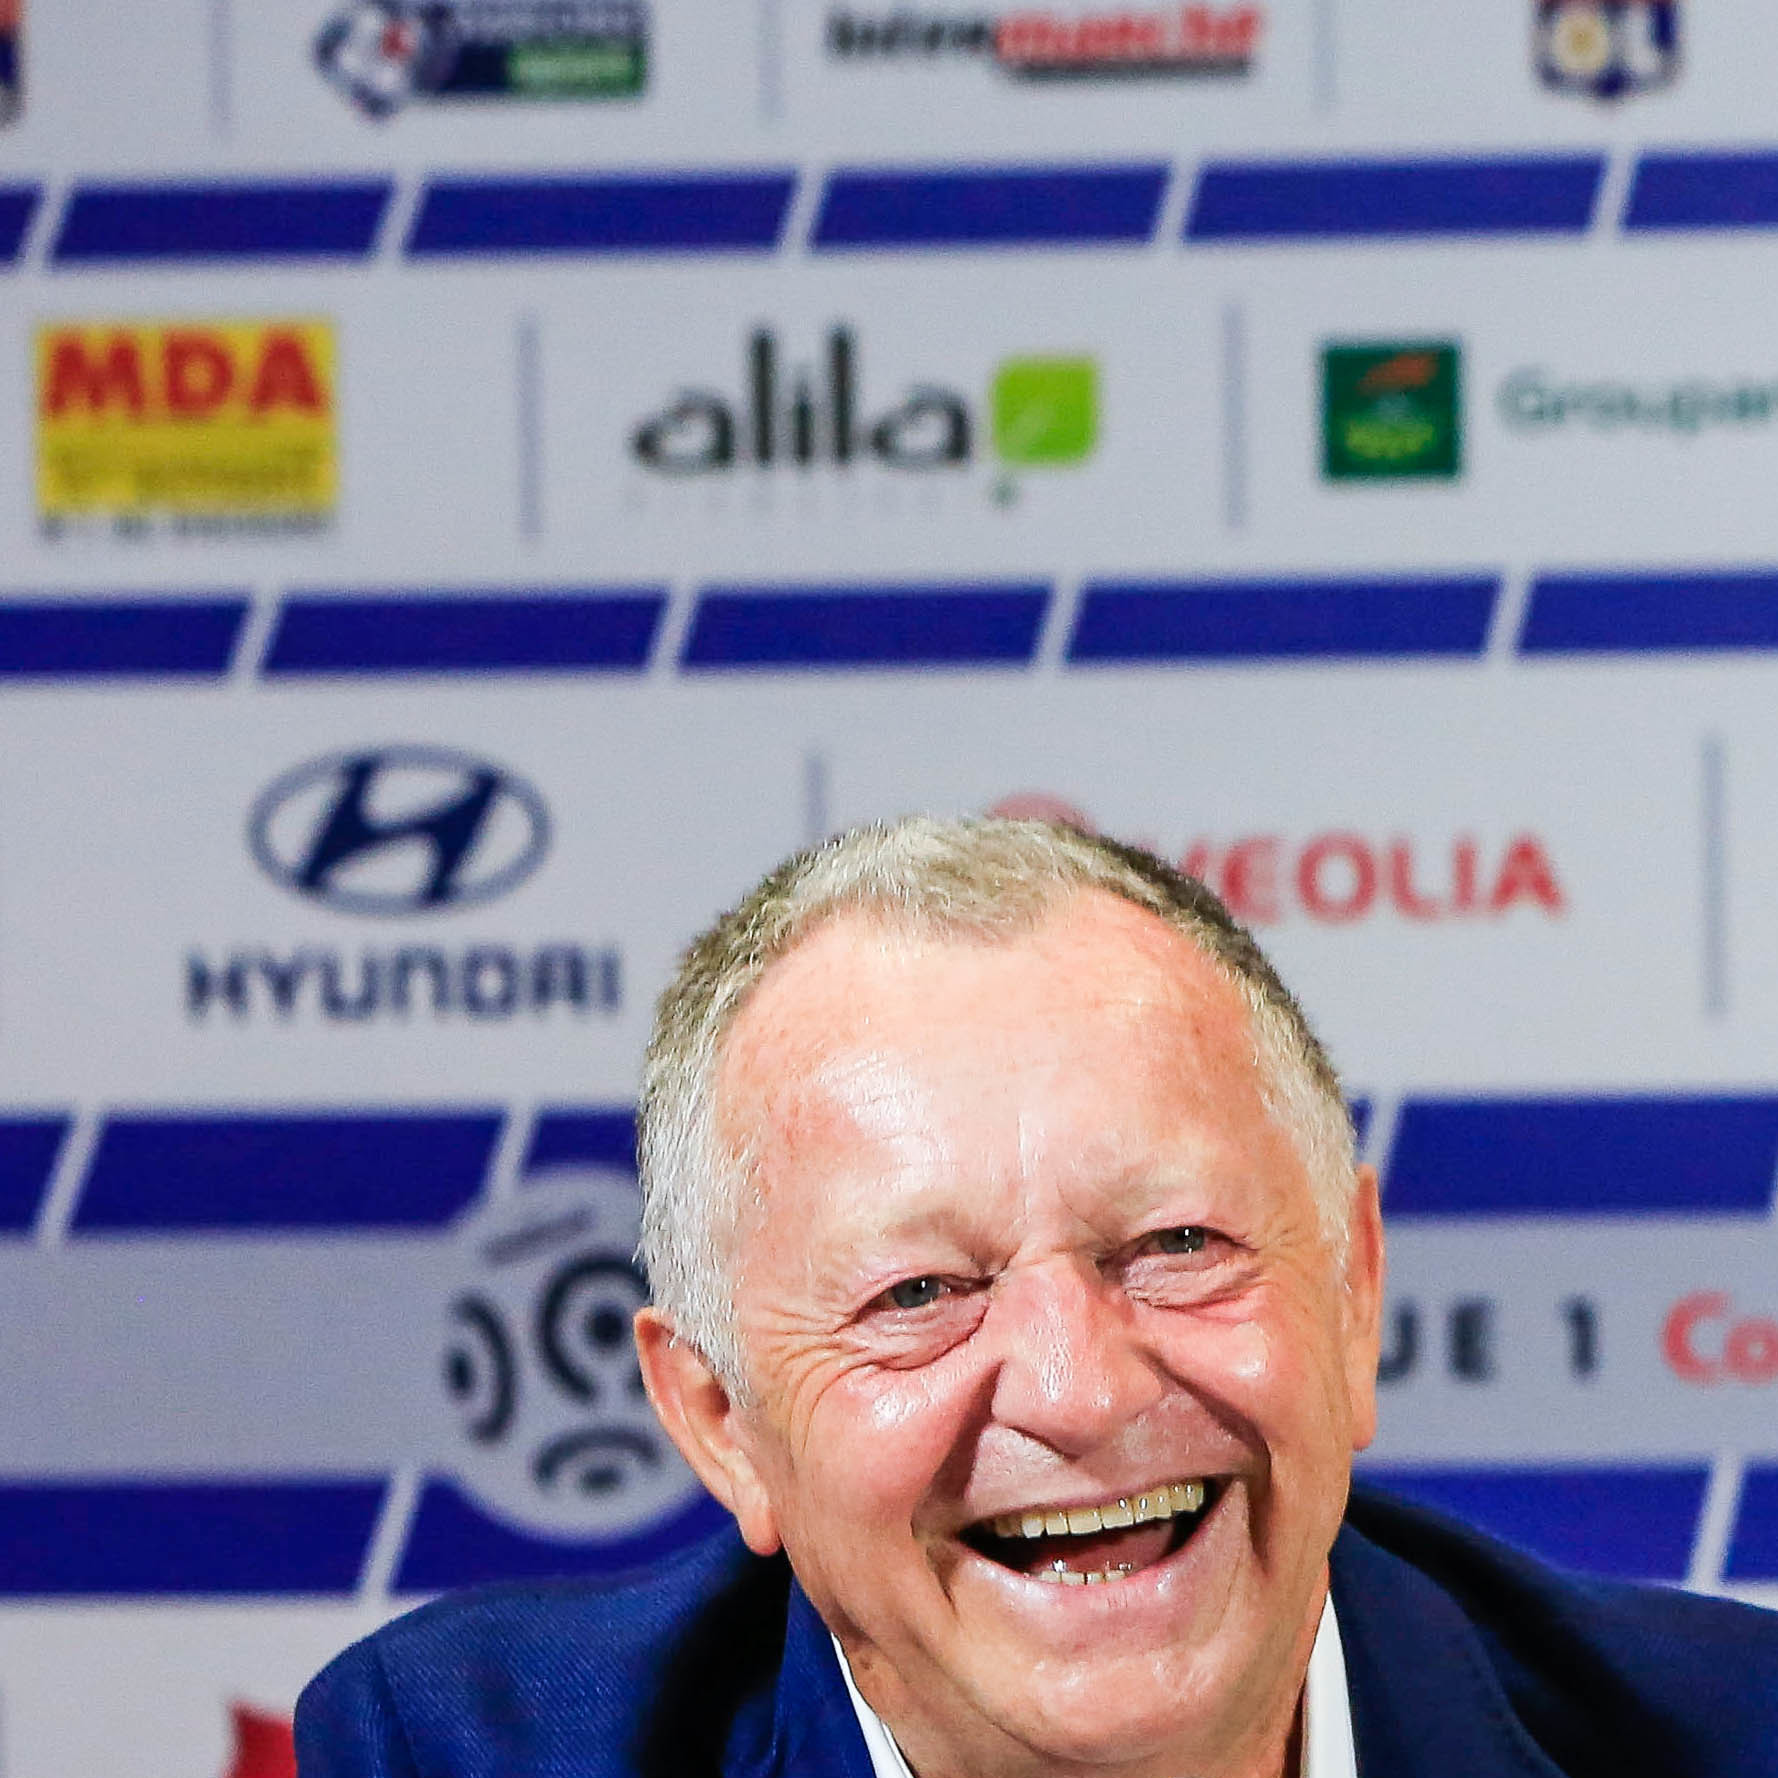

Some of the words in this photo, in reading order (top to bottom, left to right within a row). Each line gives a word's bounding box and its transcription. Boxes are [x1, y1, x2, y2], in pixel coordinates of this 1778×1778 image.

[43, 330, 324, 417] MDA
[630, 320, 975, 474] alila
[184, 944, 622, 1022] HYUNDAI
[1560, 1295, 1601, 1382] 1
